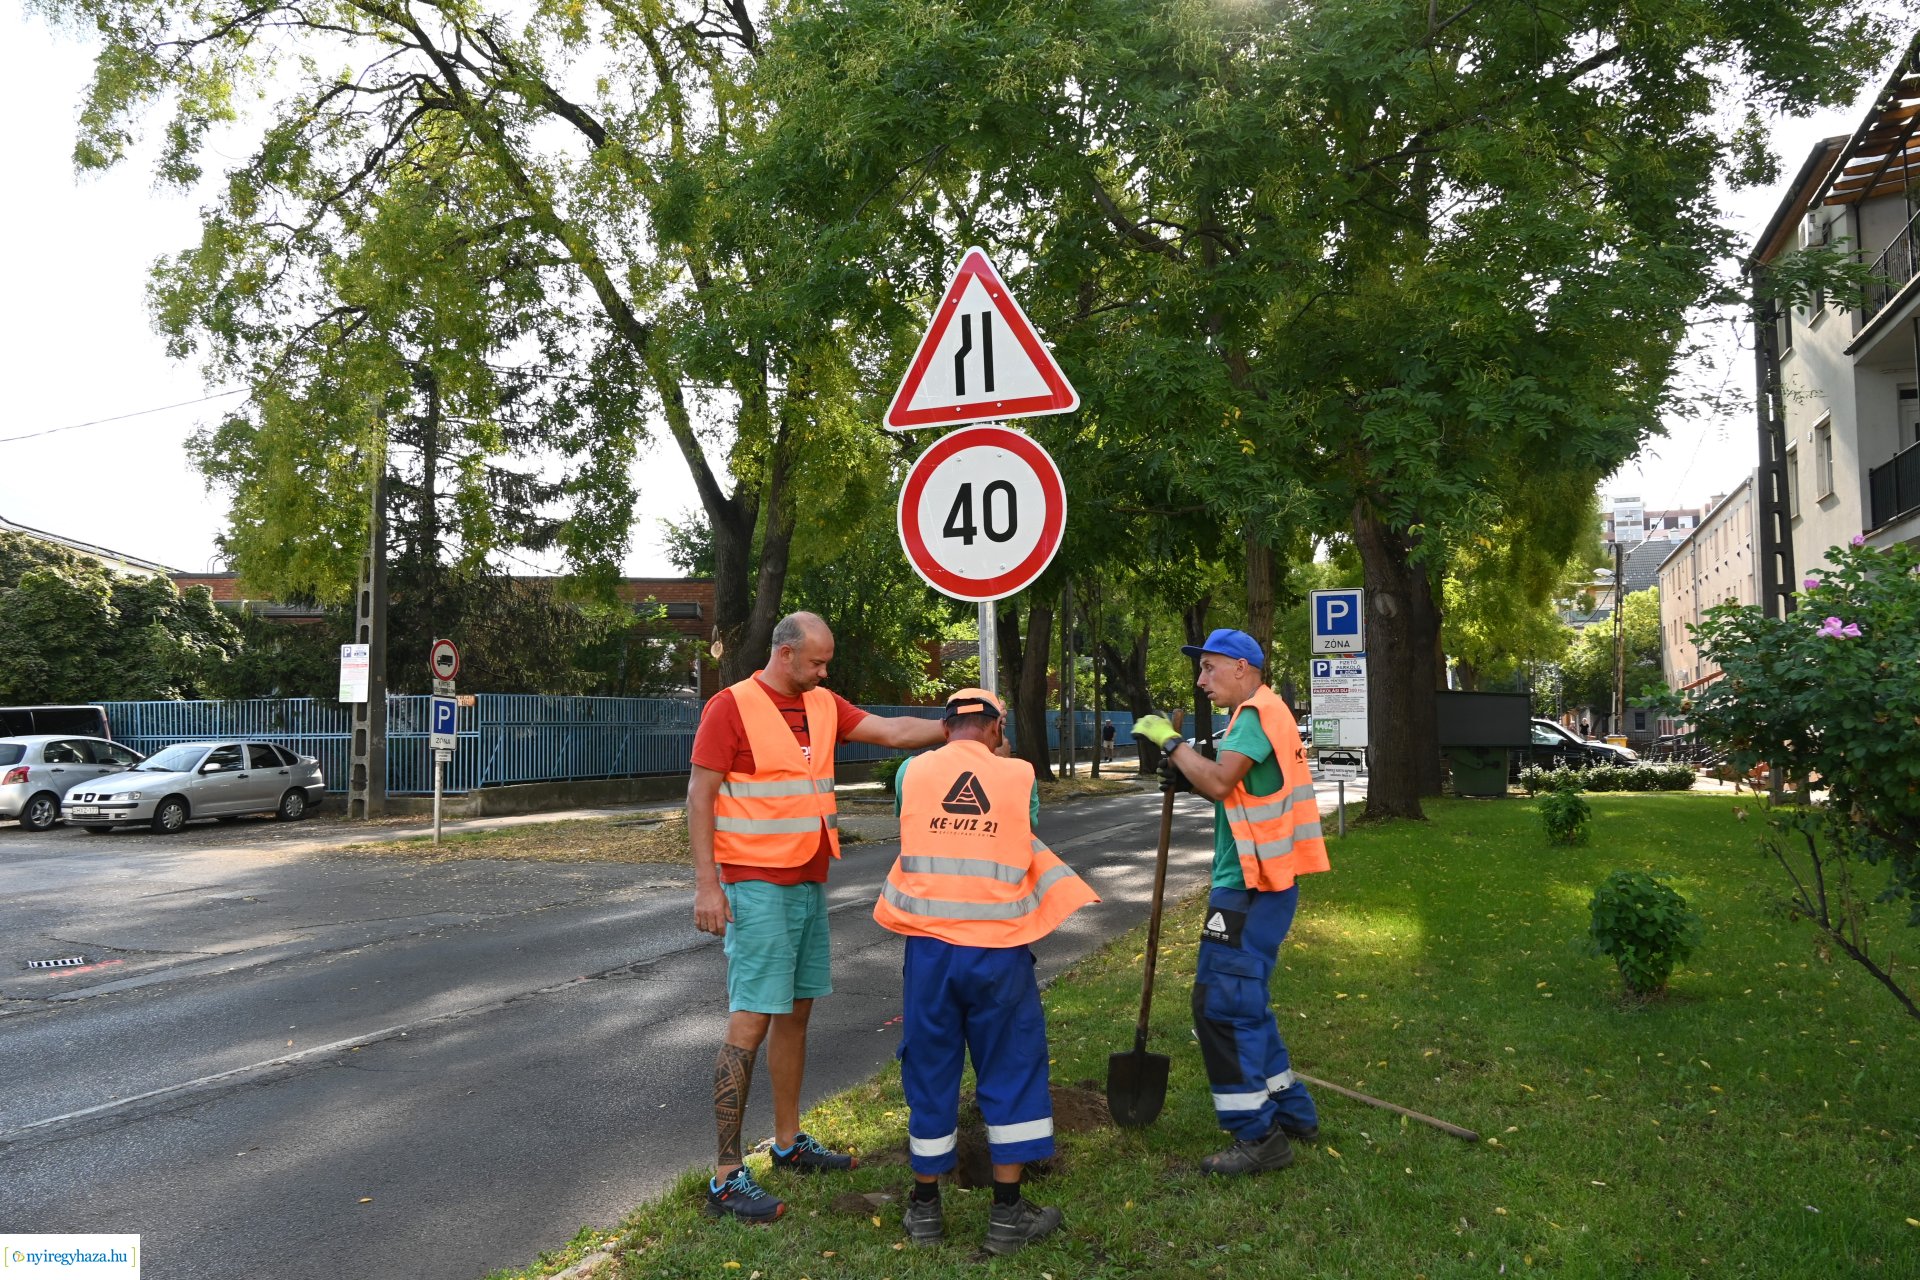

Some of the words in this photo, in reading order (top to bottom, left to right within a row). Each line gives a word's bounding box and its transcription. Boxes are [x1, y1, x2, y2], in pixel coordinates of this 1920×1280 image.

[943, 479, 1018, 546] 40
[1327, 600, 1349, 631] P
[1324, 639, 1350, 648] ZÓNA
[1316, 662, 1328, 676] P
[438, 705, 451, 730] P
[930, 817, 979, 831] KE-VIZ
[983, 820, 998, 834] 21
